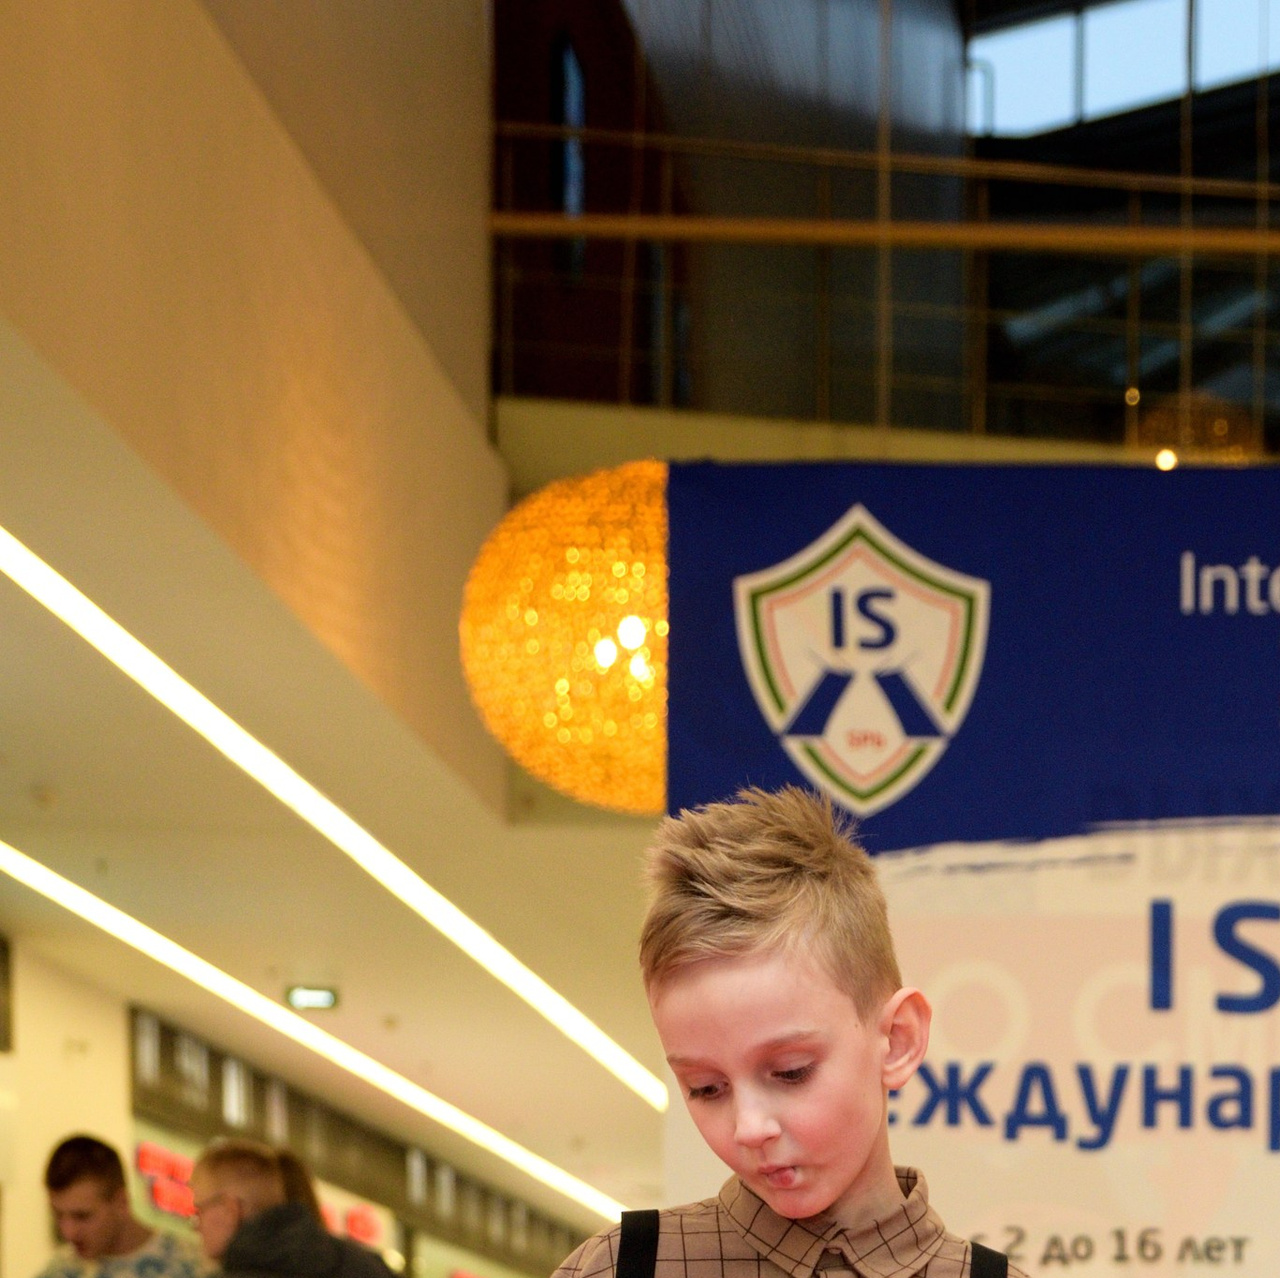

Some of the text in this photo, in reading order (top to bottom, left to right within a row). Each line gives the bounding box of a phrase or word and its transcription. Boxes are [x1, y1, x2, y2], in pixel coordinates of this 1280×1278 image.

[831, 586, 896, 650] IS
[1004, 1224, 1251, 1268] 2 до 16 лет
